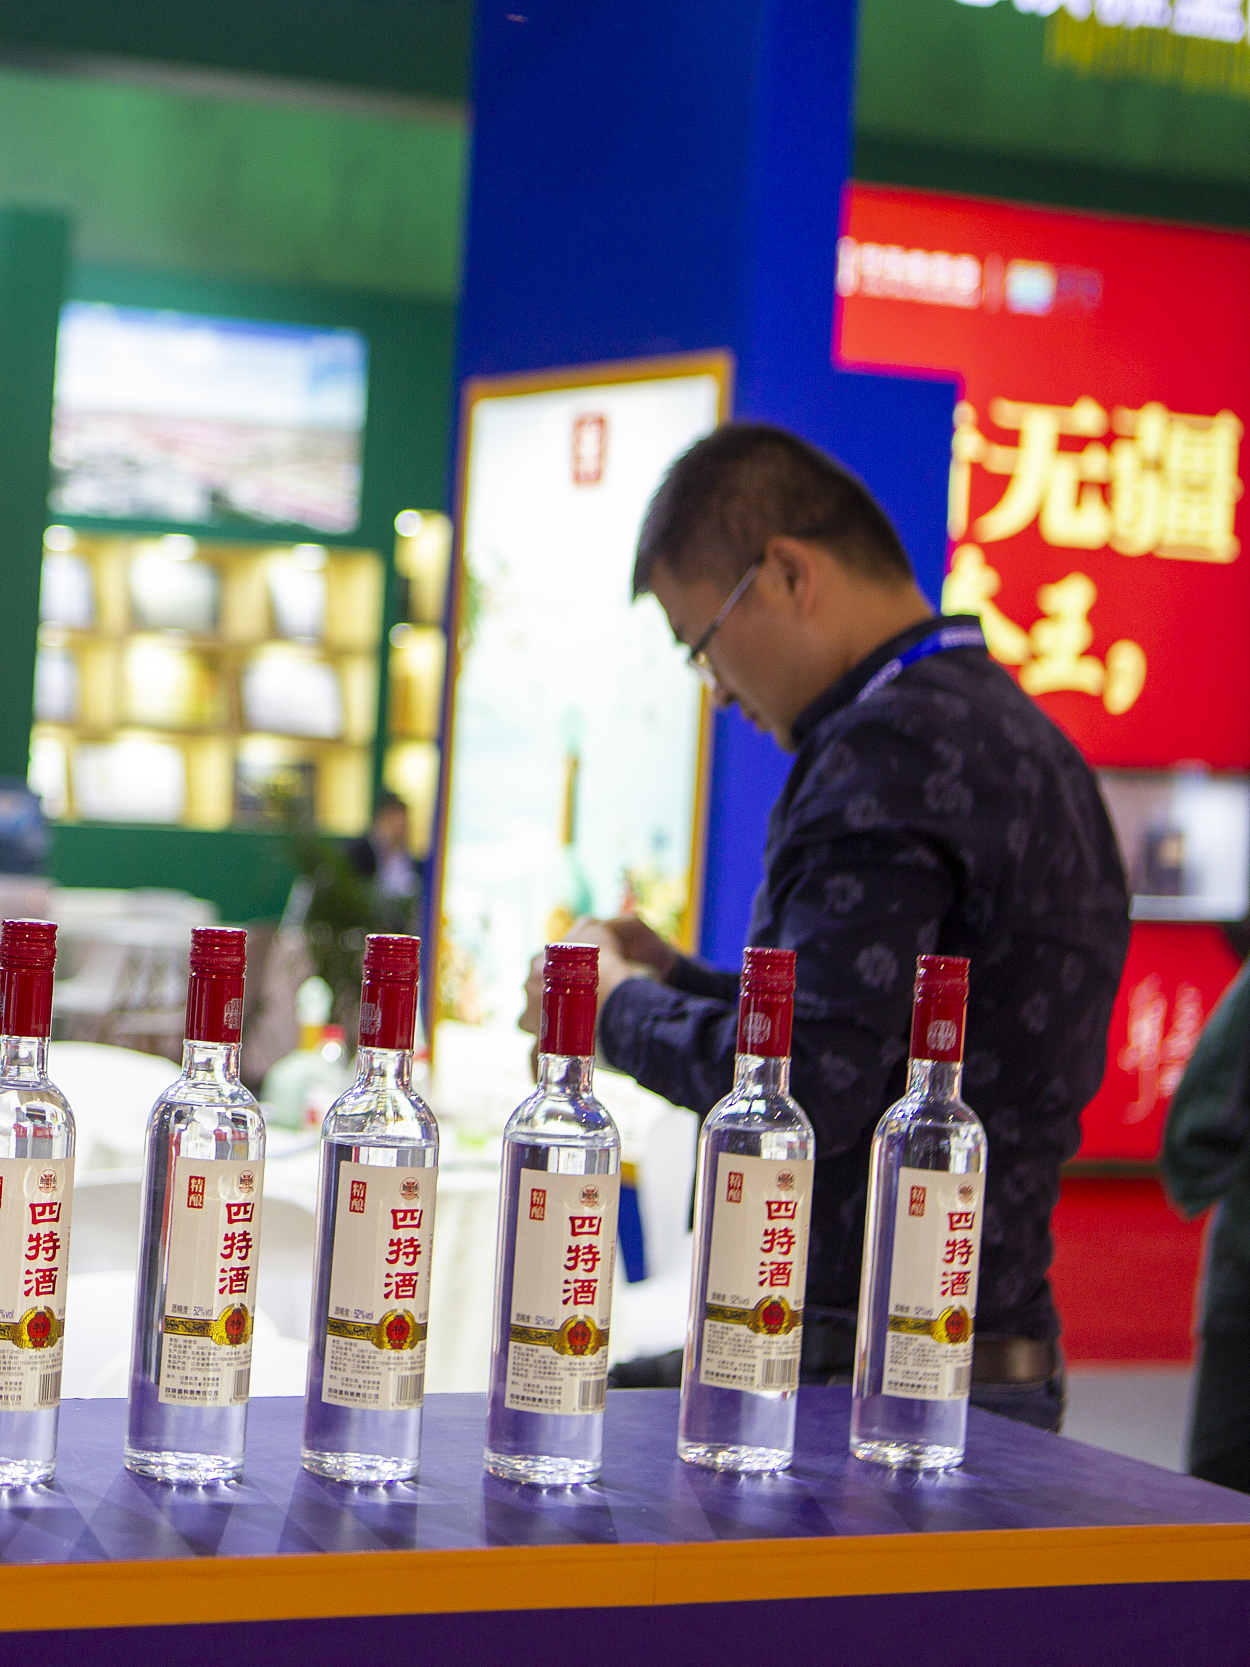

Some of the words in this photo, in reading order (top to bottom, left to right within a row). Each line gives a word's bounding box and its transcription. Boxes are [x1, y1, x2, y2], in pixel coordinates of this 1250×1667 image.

[187, 1176, 205, 1209] 精酿
[349, 1180, 367, 1213] 精酿
[24, 1201, 61, 1297] 四特酒
[219, 1202, 254, 1294] 四特酒
[384, 1208, 422, 1299] 四特酒
[563, 1215, 602, 1306] 四特酒
[758, 1200, 797, 1287] 四特酒
[940, 1211, 975, 1297] 四特酒
